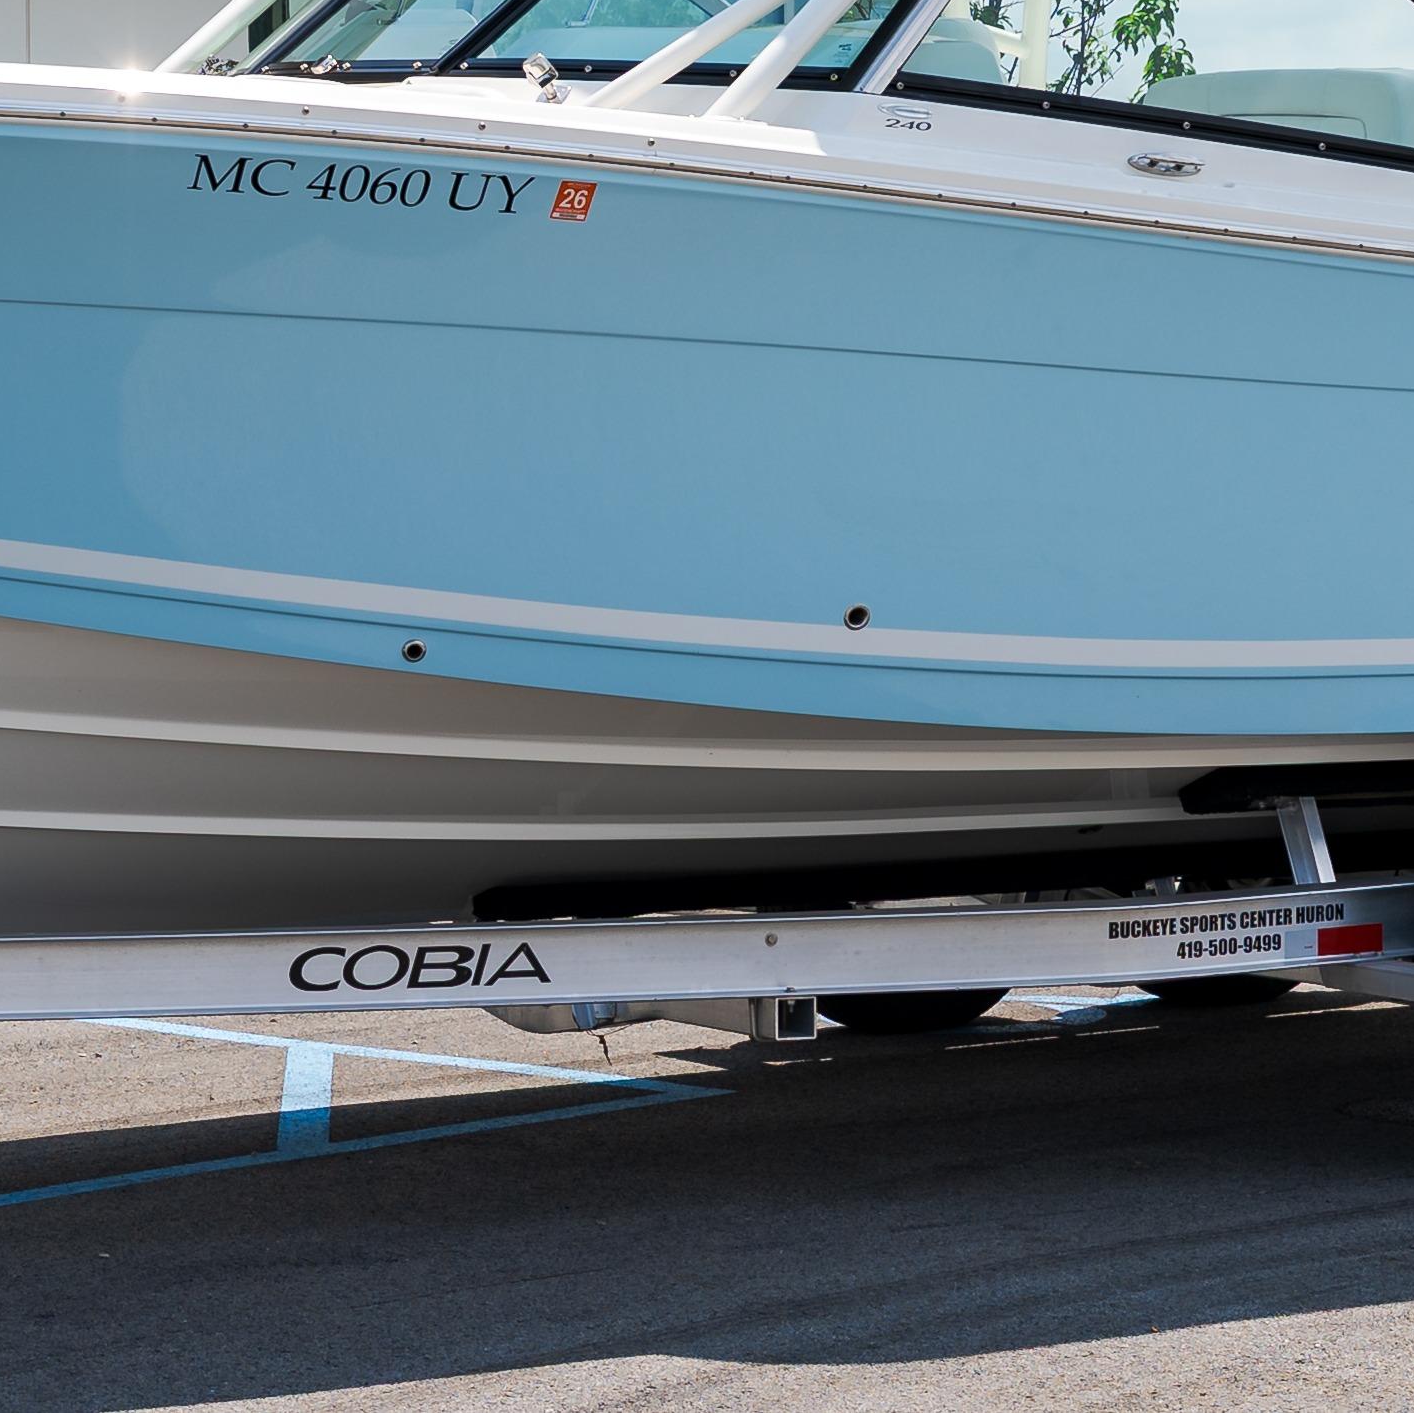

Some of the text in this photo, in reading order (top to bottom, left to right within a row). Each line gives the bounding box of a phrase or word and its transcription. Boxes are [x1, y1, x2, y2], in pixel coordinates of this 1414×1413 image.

[885, 118, 932, 132] 240
[187, 152, 536, 214] MC 4060 UY
[559, 188, 589, 209] 26
[1108, 903, 1344, 939] BUCKEYE SPORTS CENTER HURON
[1177, 934, 1282, 960] 419-500-9499
[289, 942, 552, 992] COBIA
